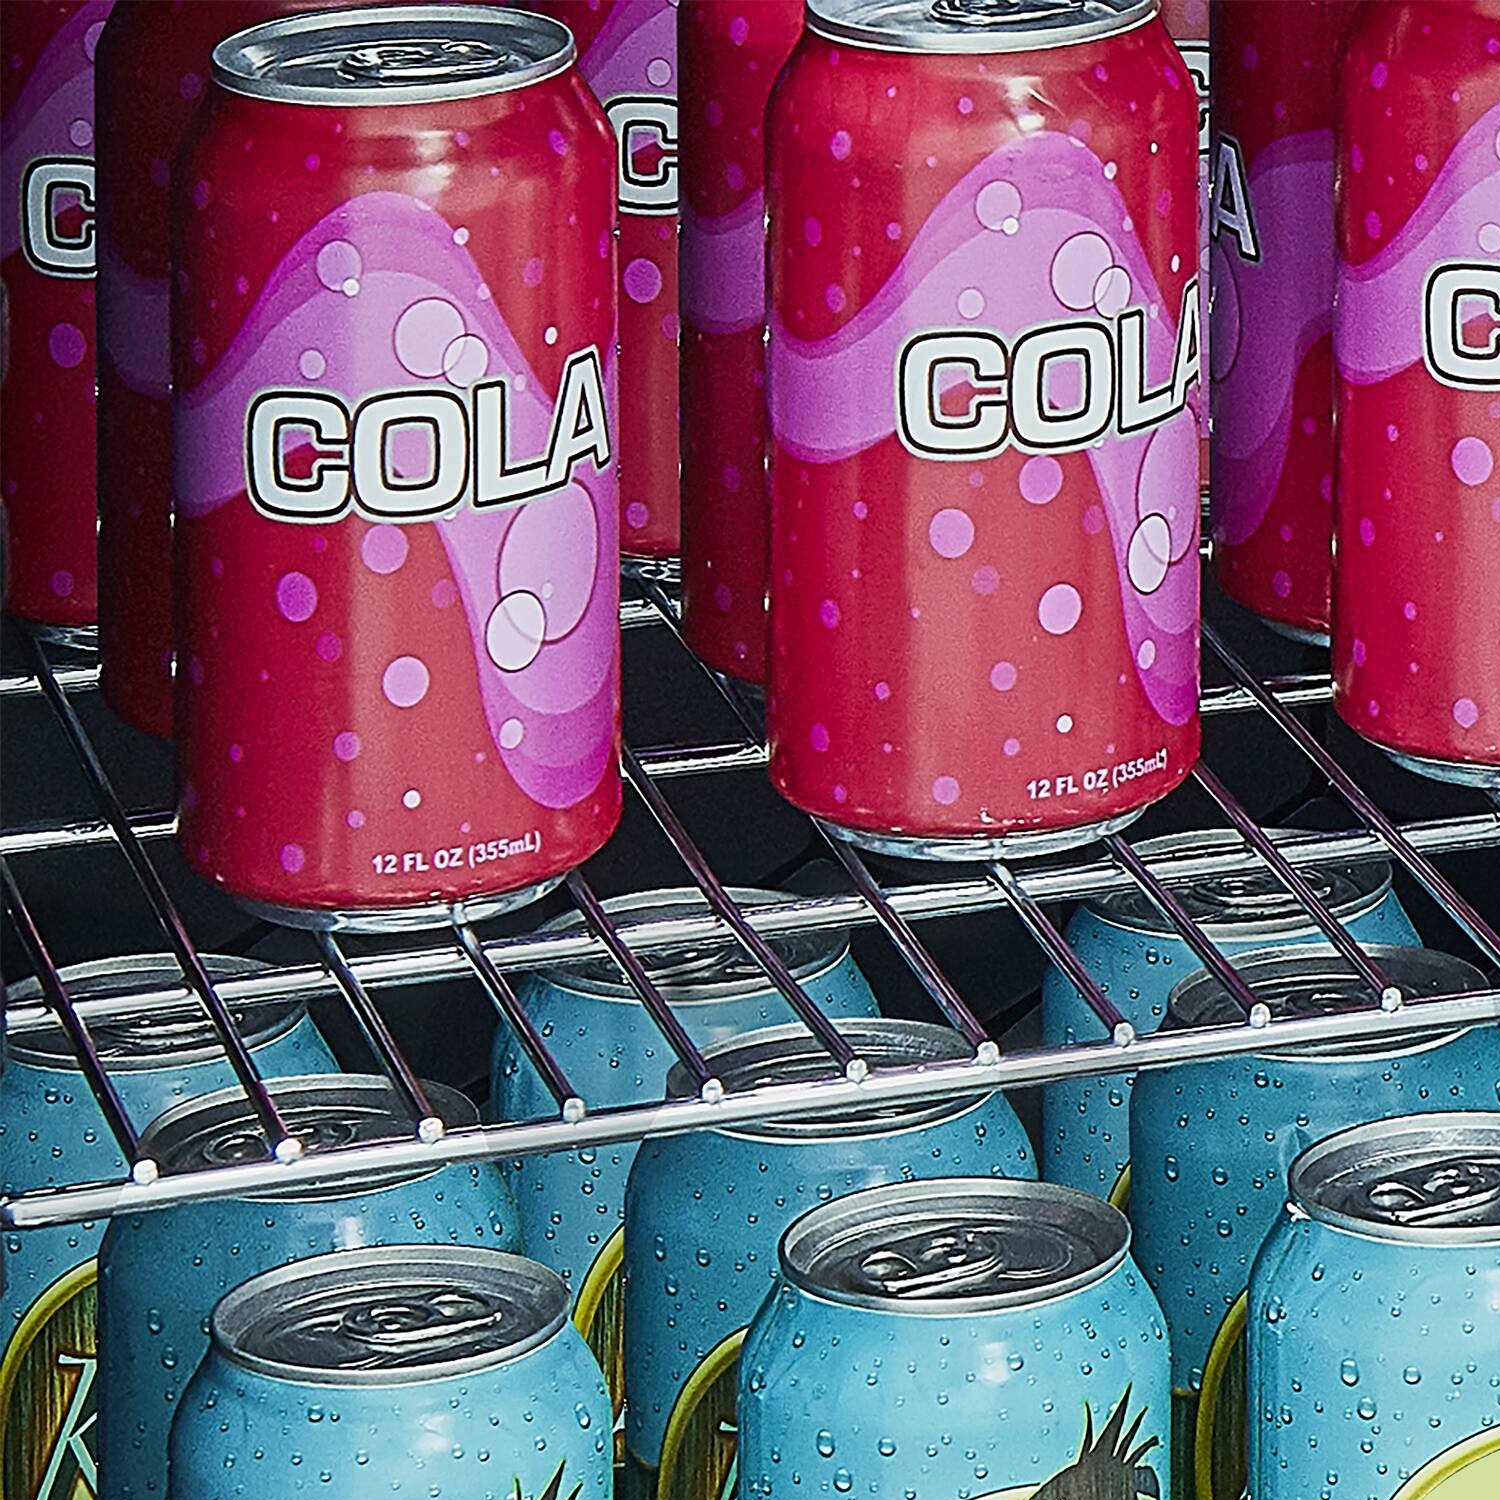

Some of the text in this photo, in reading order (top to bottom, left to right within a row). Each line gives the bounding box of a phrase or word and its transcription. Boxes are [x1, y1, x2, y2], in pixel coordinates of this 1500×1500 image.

[897, 281, 1201, 461] COLA
[245, 344, 610, 523] COLA
[1026, 748, 1167, 799] 12 FL OZ (355mL)
[372, 831, 541, 874] 12 FL OZ (355mL)
